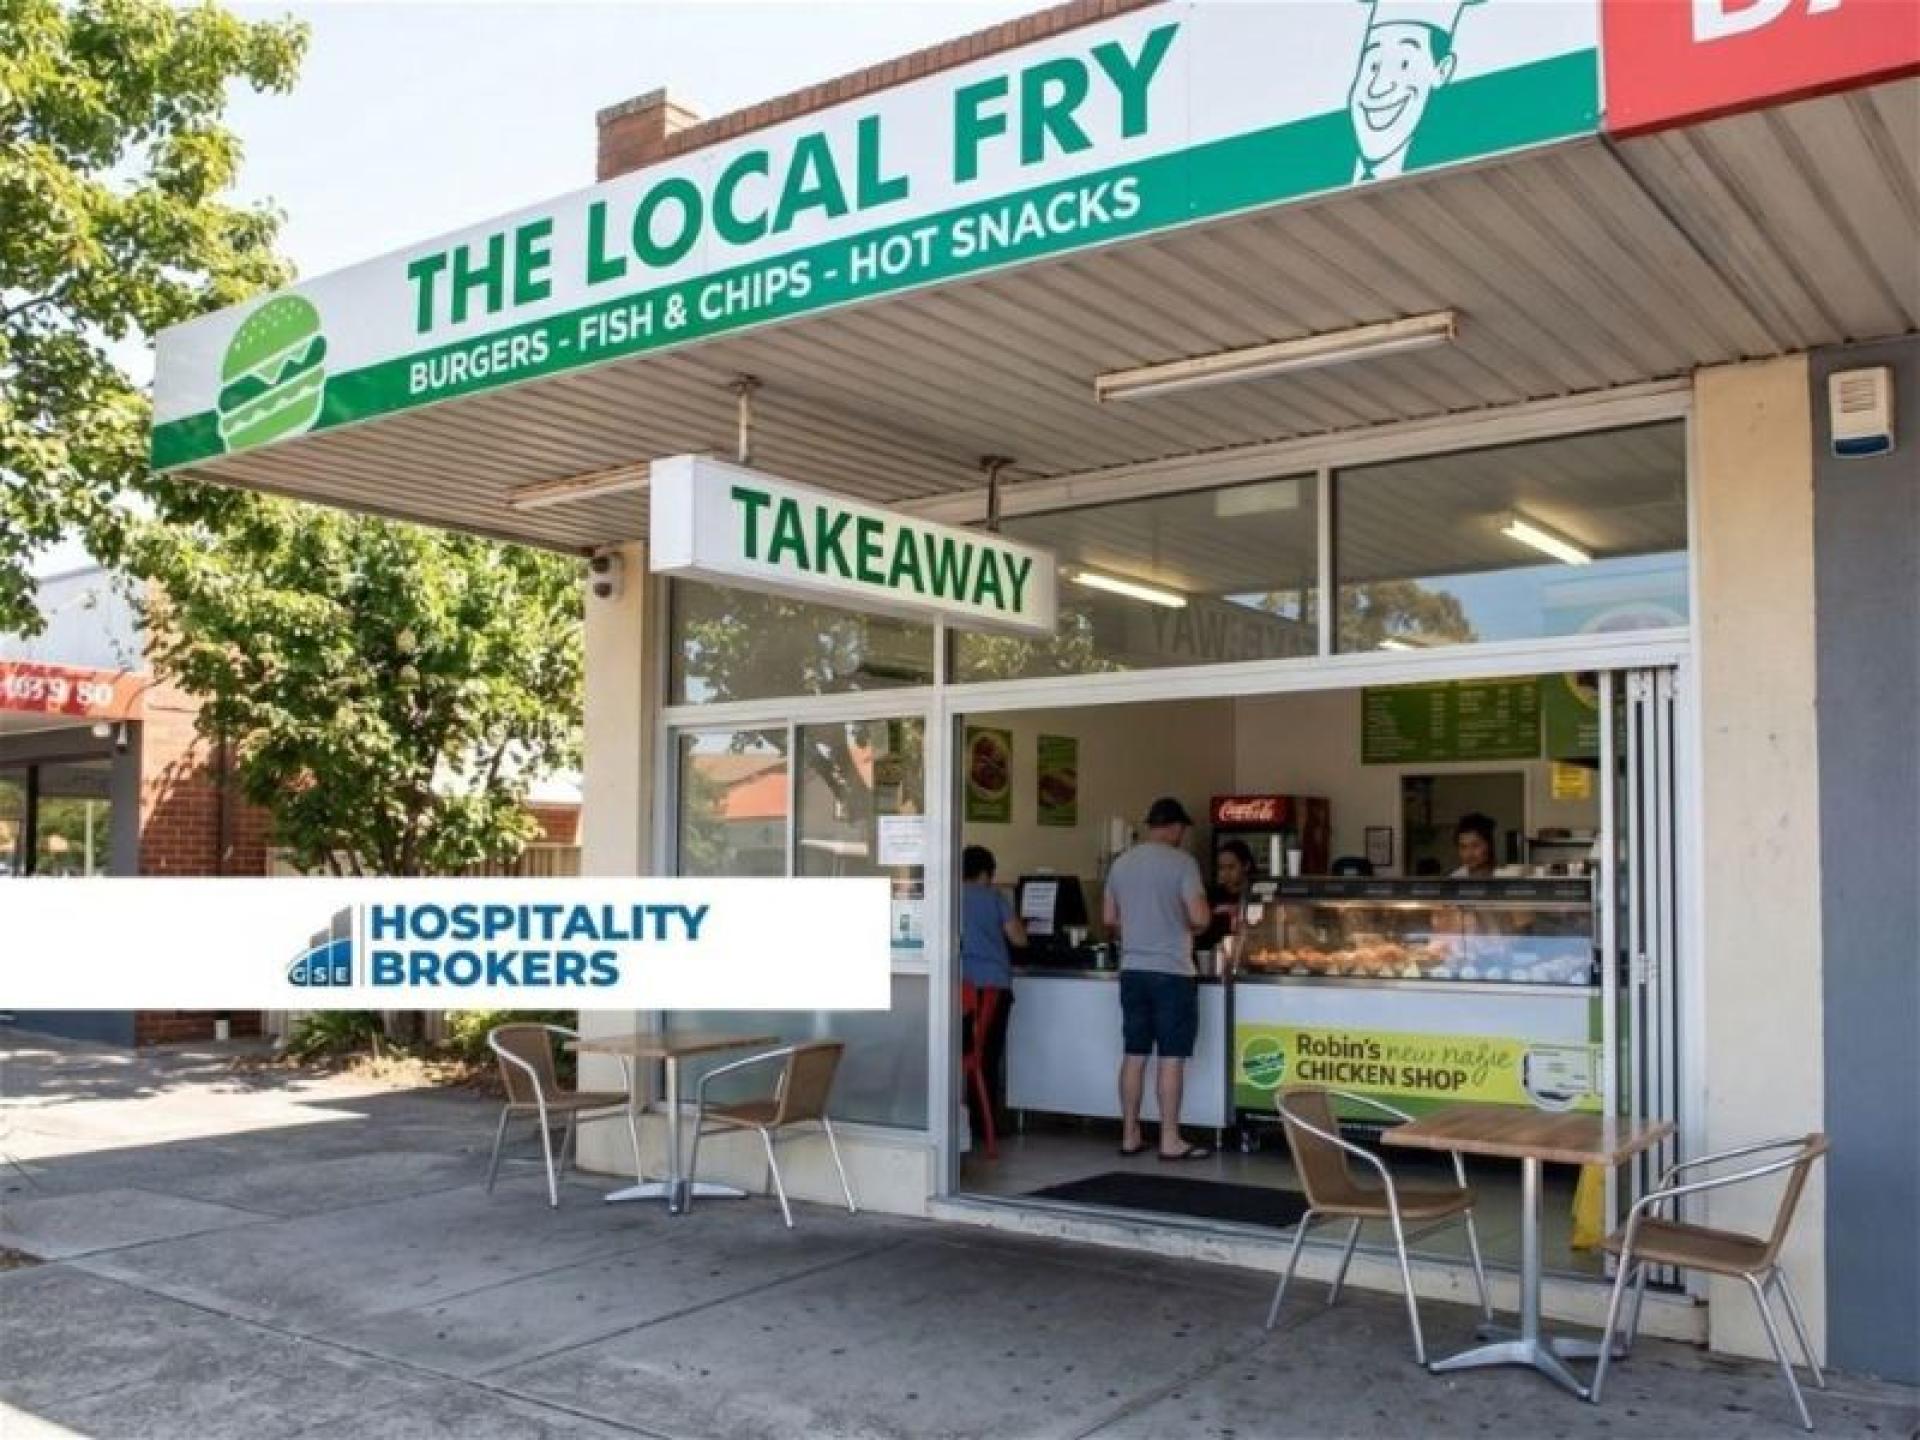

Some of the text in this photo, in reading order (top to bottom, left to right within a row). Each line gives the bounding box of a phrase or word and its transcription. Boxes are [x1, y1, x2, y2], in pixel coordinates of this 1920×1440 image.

[407, 21, 1181, 333] THE LOCAL FRY
[409, 335, 550, 394] BURGERS
[579, 302, 653, 353] FISH
[663, 295, 688, 330] &
[700, 260, 812, 321] CHIPS
[850, 226, 939, 284] HOT
[950, 177, 1142, 258] SNACKS
[731, 486, 1033, 614] TAKEAWAY
[1295, 1033, 1382, 1060] Robin's
[1295, 1059, 1468, 1091] CHICKEN SHOP
